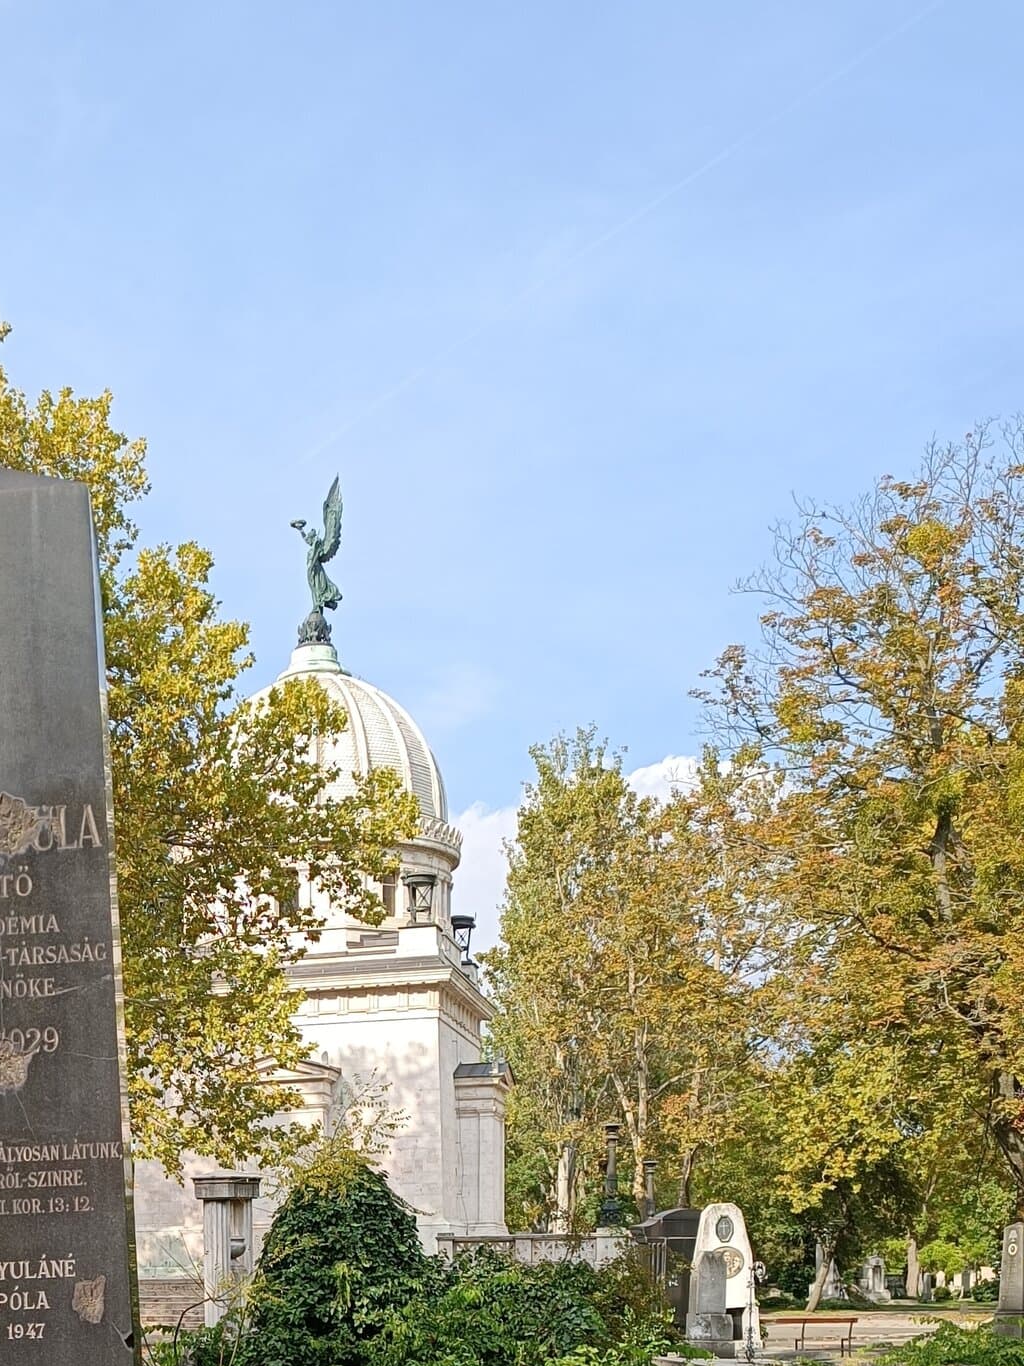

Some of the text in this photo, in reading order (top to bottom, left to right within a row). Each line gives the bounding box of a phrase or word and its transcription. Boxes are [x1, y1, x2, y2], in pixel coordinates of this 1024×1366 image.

[63, 1139, 123, 1160] LÁTUNK,
[12, 1198, 45, 1215] KOR.
[7, 1323, 46, 1340] 1947
